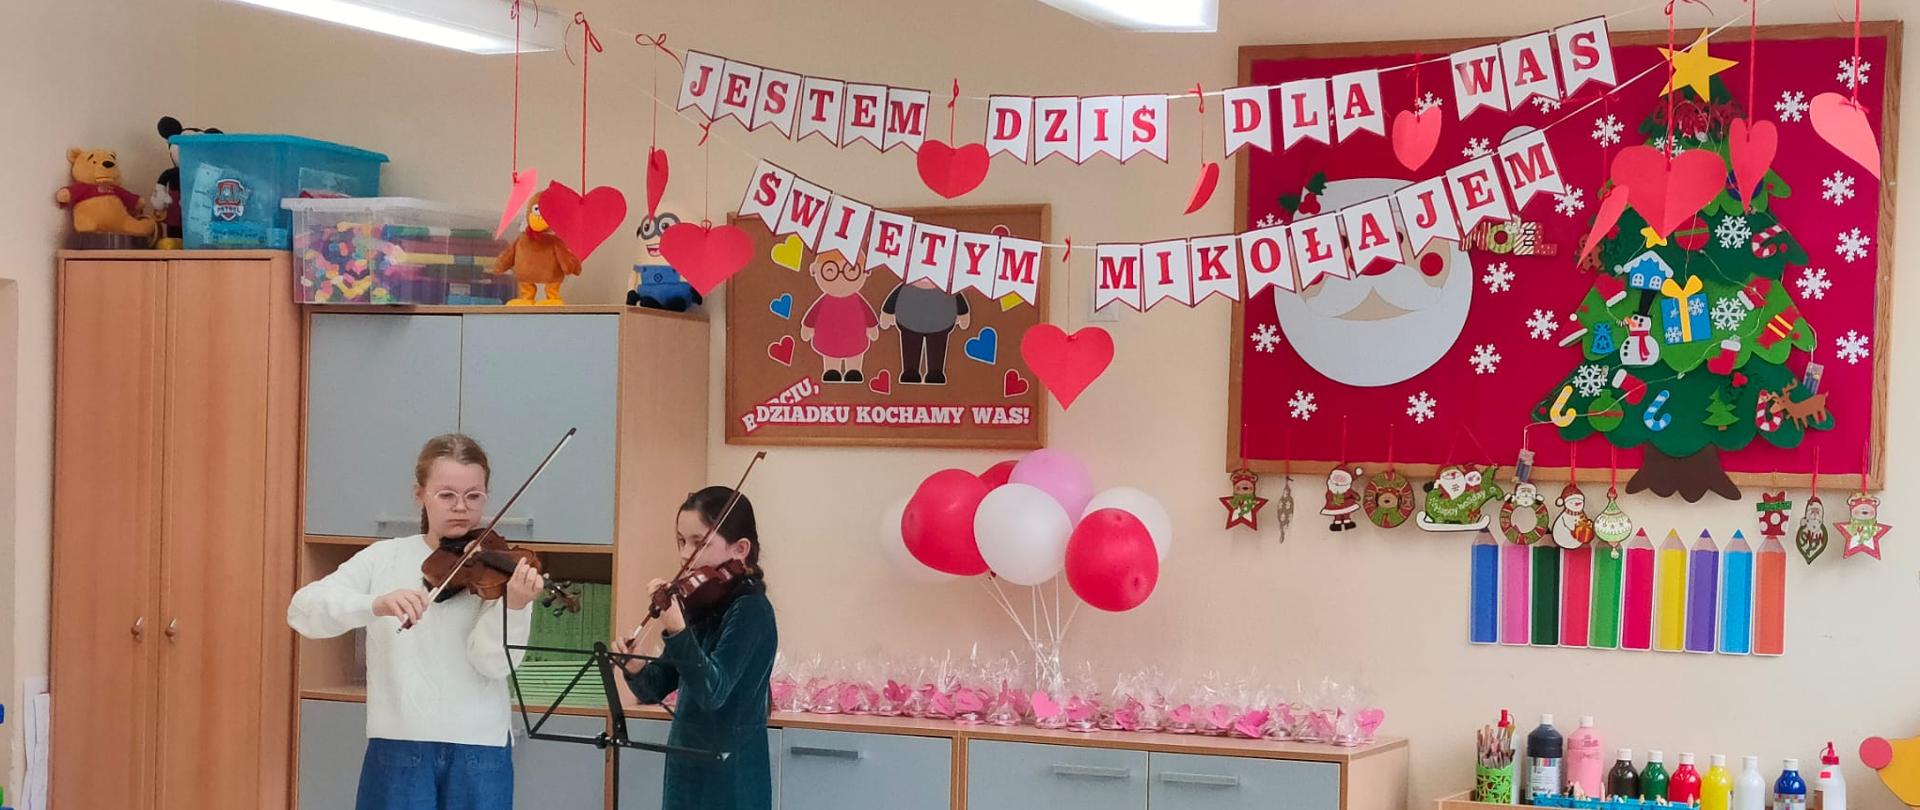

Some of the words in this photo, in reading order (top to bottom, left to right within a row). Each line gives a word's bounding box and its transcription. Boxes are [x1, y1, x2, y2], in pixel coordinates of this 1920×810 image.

[689, 65, 925, 136] JESTEM
[993, 105, 1157, 142] DZIŚ
[1231, 82, 1375, 134] DLA
[1455, 31, 1601, 97] WAS
[753, 171, 1038, 285] ŚWIĘTYM
[1099, 142, 1556, 290] MIKOŁAJEM
[756, 405, 849, 424] DZIADKU
[856, 406, 965, 424] KOCHAMY
[972, 406, 1030, 424] WAS!
